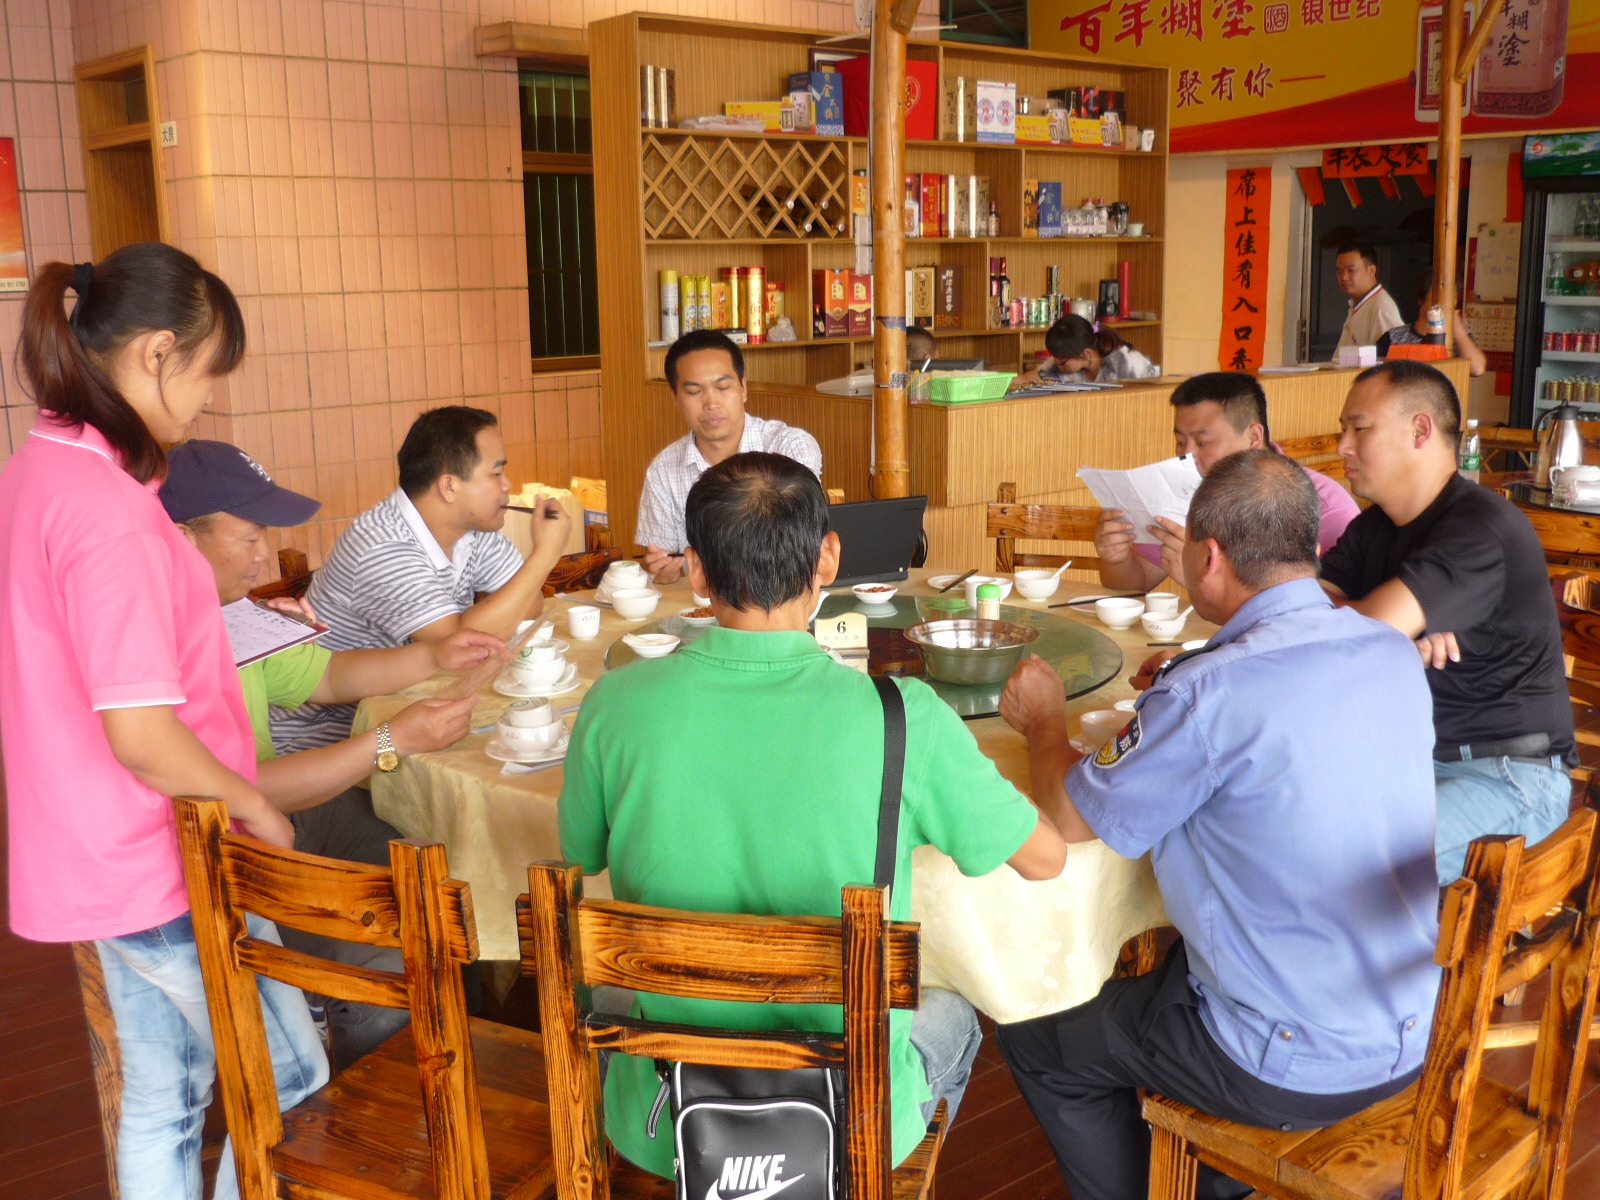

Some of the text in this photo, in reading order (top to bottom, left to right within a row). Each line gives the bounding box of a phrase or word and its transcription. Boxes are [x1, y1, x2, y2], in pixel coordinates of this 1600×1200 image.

[1301, 0, 1381, 26] 银世纪
[836, 620, 847, 635] 6
[719, 1154, 786, 1191] NIKE
